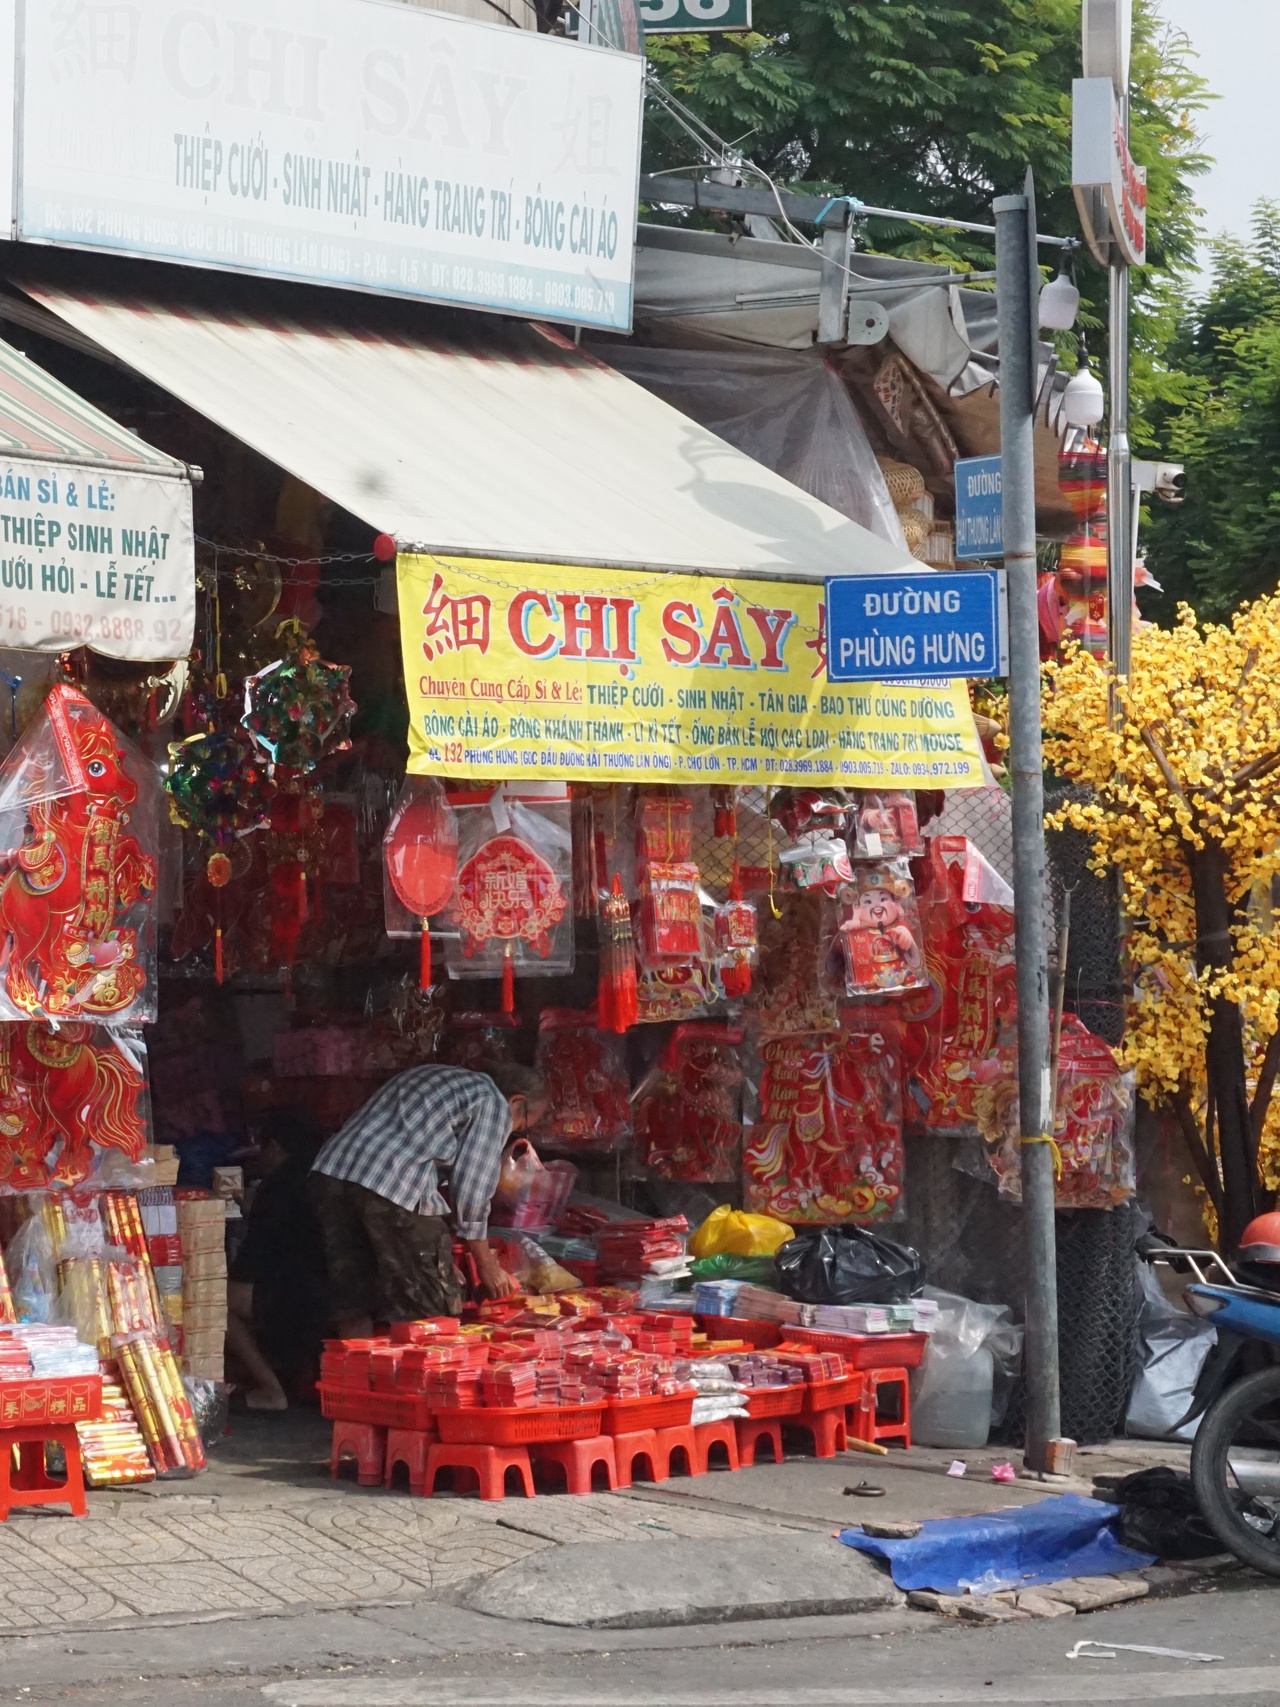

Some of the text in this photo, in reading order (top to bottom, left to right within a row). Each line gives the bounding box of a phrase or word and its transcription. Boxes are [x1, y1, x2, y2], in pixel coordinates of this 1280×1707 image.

[161, 9, 328, 144] CHỊ
[360, 36, 528, 157] SÂY
[174, 121, 222, 205] THIỆP
[228, 131, 268, 201] CƯỚI
[283, 151, 322, 210] SINH
[327, 148, 371, 231] NHẬT
[383, 156, 429, 228] HÀNG
[434, 179, 485, 238] TRANG
[490, 176, 514, 242] TRÍ
[524, 182, 565, 251] BÔNG
[570, 190, 593, 256] CÀI
[596, 194, 618, 260] ÁO
[70, 207, 92, 233] 132
[37, 472, 59, 505] SỈ
[65, 481, 79, 507] &
[87, 479, 115, 511] LẺ:
[967, 469, 1002, 498] ĐƯỜNG
[0, 512, 62, 554] THIỆP
[67, 523, 113, 555] SINH
[122, 525, 170, 566] NHẬT
[41, 557, 74, 595] HỎI
[95, 561, 117, 599] LỄ
[422, 572, 491, 662] 細
[863, 587, 961, 617] ĐƯỜNG
[508, 590, 639, 680] CHỊ
[661, 586, 796, 672] SÂY
[840, 628, 915, 668] PHÙNG
[923, 631, 985, 664] HƯNG
[419, 675, 465, 700] Chuyên
[470, 677, 504, 703] Cung
[507, 676, 530, 704] Cấp
[587, 680, 628, 709] THIỆP
[633, 682, 664, 707] CƯỚI
[677, 688, 706, 709] SINH
[711, 686, 744, 715] NHẬT
[758, 687, 783, 713] TÂN
[788, 694, 808, 714] GIA
[821, 695, 844, 715] BAO
[847, 695, 872, 716] THƯ
[875, 694, 907, 718] CÚNG
[911, 695, 955, 719] DƯỜNG
[424, 709, 455, 736] BÔNG
[458, 710, 478, 737] CÀI
[482, 711, 498, 738] ÁO
[661, 717, 682, 744] TẾT
[691, 717, 715, 745] ỐNG
[781, 724, 802, 748] CÁC
[838, 726, 865, 750] HÀNG
[868, 732, 899, 751] TRANG
[444, 742, 463, 763] 132
[464, 746, 493, 764] PHÙNG
[93, 973, 120, 1004] 福
